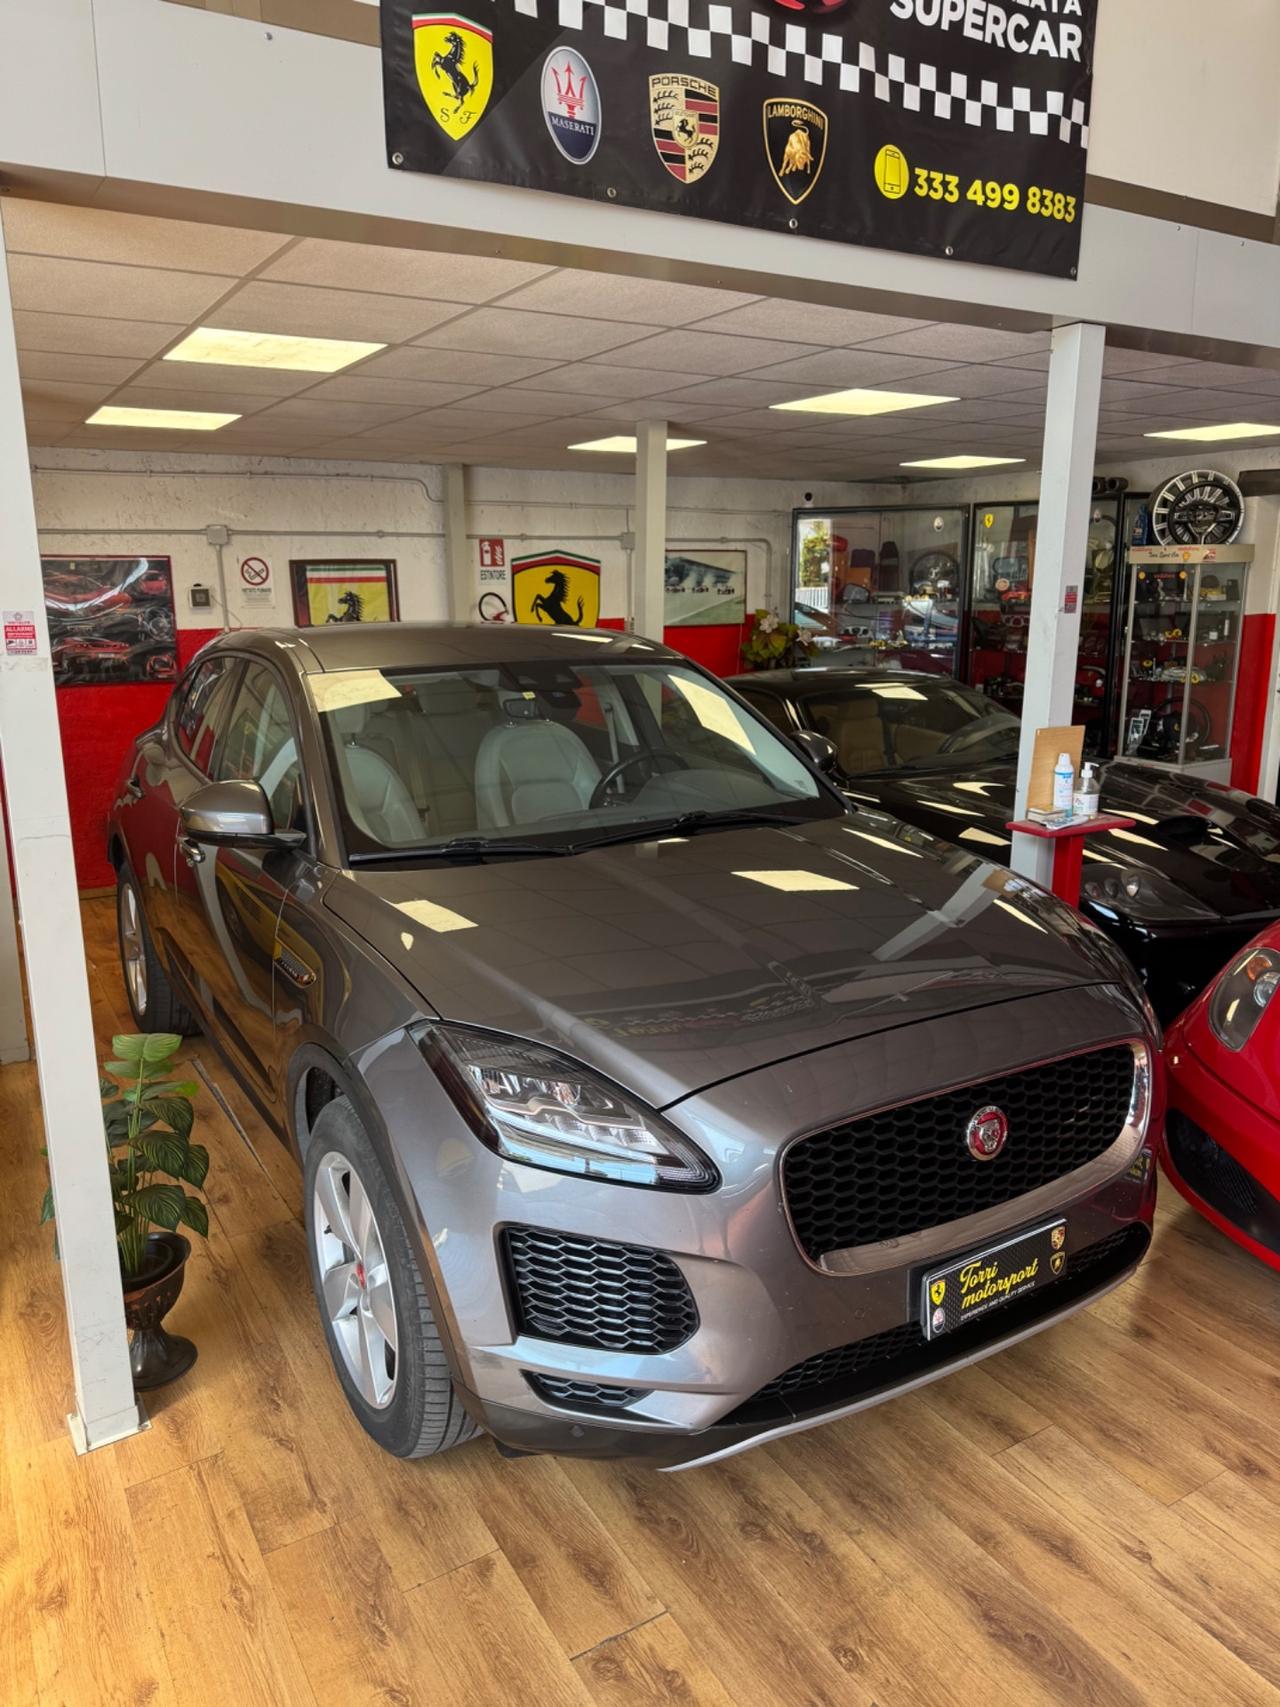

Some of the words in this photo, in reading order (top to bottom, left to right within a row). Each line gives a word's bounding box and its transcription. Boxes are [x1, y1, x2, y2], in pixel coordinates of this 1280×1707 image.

[890, 0, 1082, 62] SUPERCAR
[652, 76, 716, 97] PORSCHE
[551, 115, 595, 136] MASERATI
[767, 104, 823, 130] LAMBORGHINI
[914, 167, 960, 203] 333
[966, 179, 1020, 210] 499
[1026, 186, 1076, 223] 8383
[959, 1261, 998, 1294] Torri
[962, 1258, 1039, 1309] motorsport
